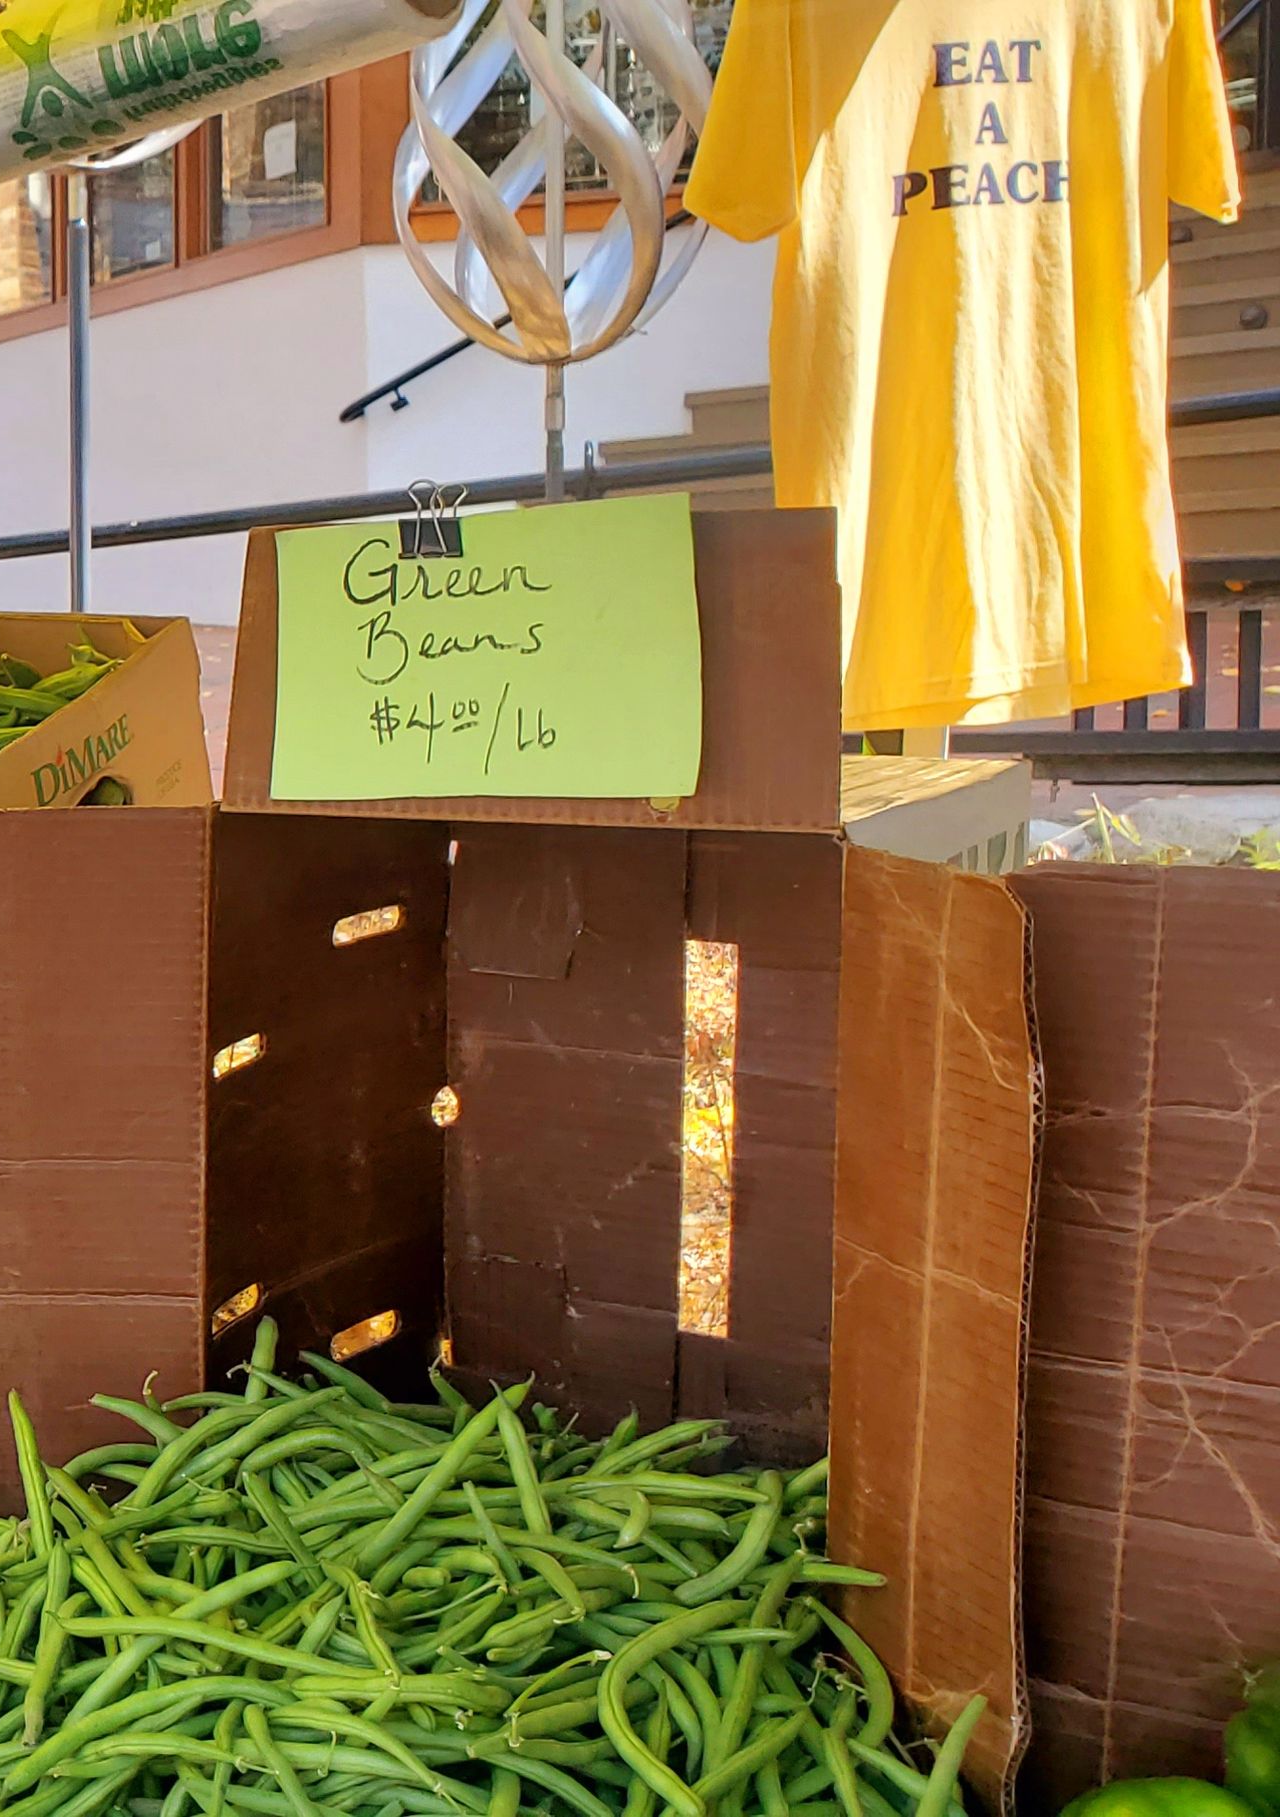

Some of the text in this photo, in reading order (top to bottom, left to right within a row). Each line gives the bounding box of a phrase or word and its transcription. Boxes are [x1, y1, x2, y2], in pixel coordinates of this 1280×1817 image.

[932, 39, 1041, 87] EAT
[975, 101, 1008, 144] A
[892, 160, 1070, 217] PEACH
[343, 538, 552, 607] Green
[357, 610, 544, 686] Beans
